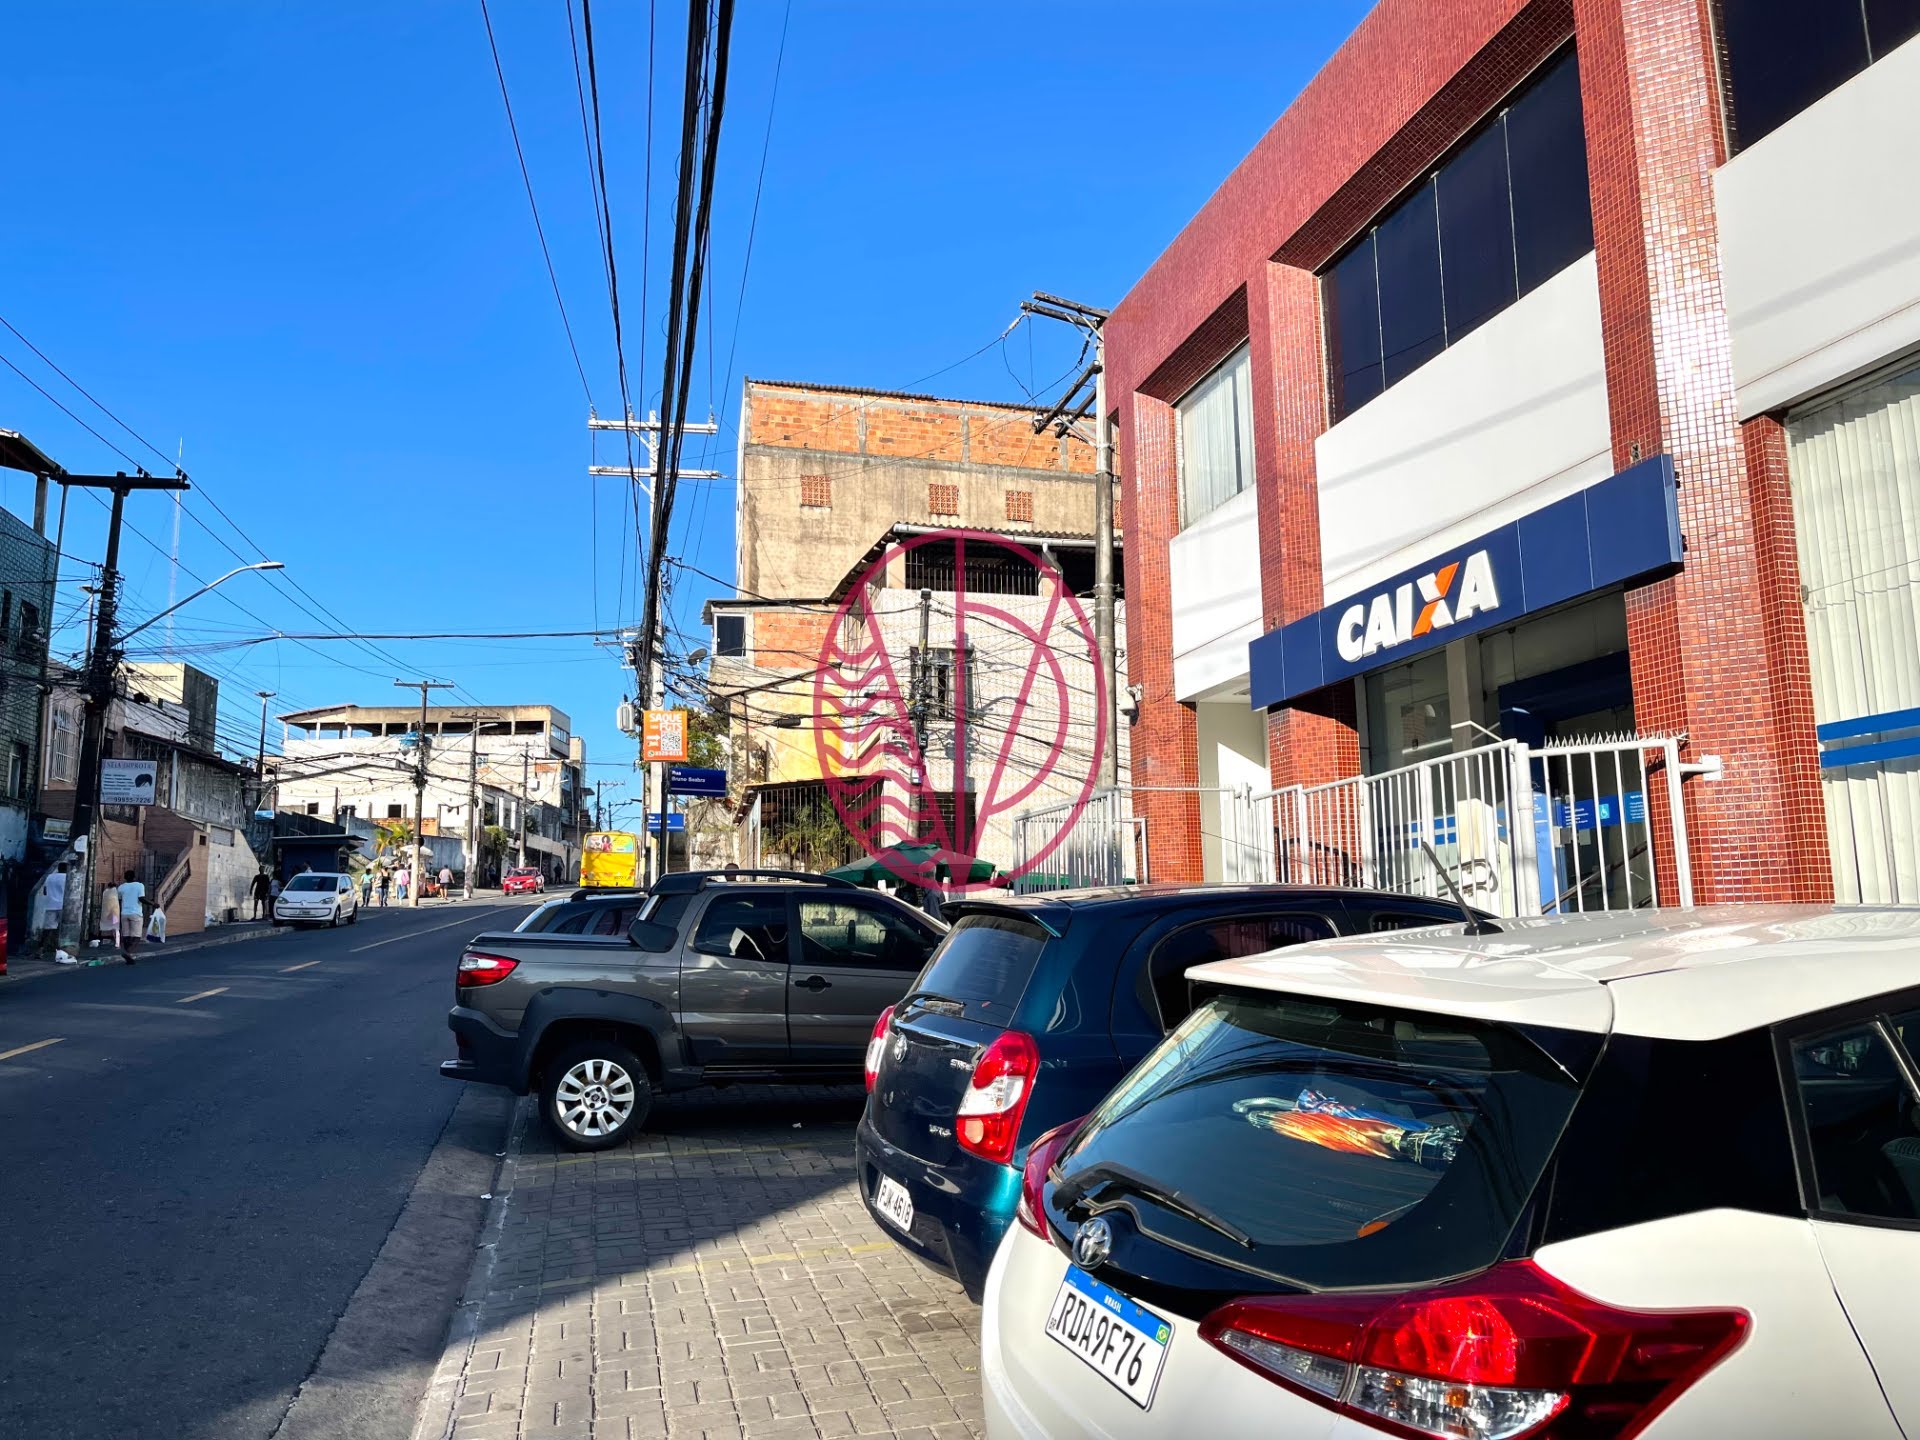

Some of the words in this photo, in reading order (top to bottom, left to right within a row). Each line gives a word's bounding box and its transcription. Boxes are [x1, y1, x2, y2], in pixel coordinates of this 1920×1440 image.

[1337, 549, 1499, 663] CAIXA
[649, 713, 682, 722] SAQUE
[660, 722, 682, 731] FGTS
[1103, 1295, 1123, 1313] BRASIL
[1056, 1292, 1147, 1387] RDA9F76
